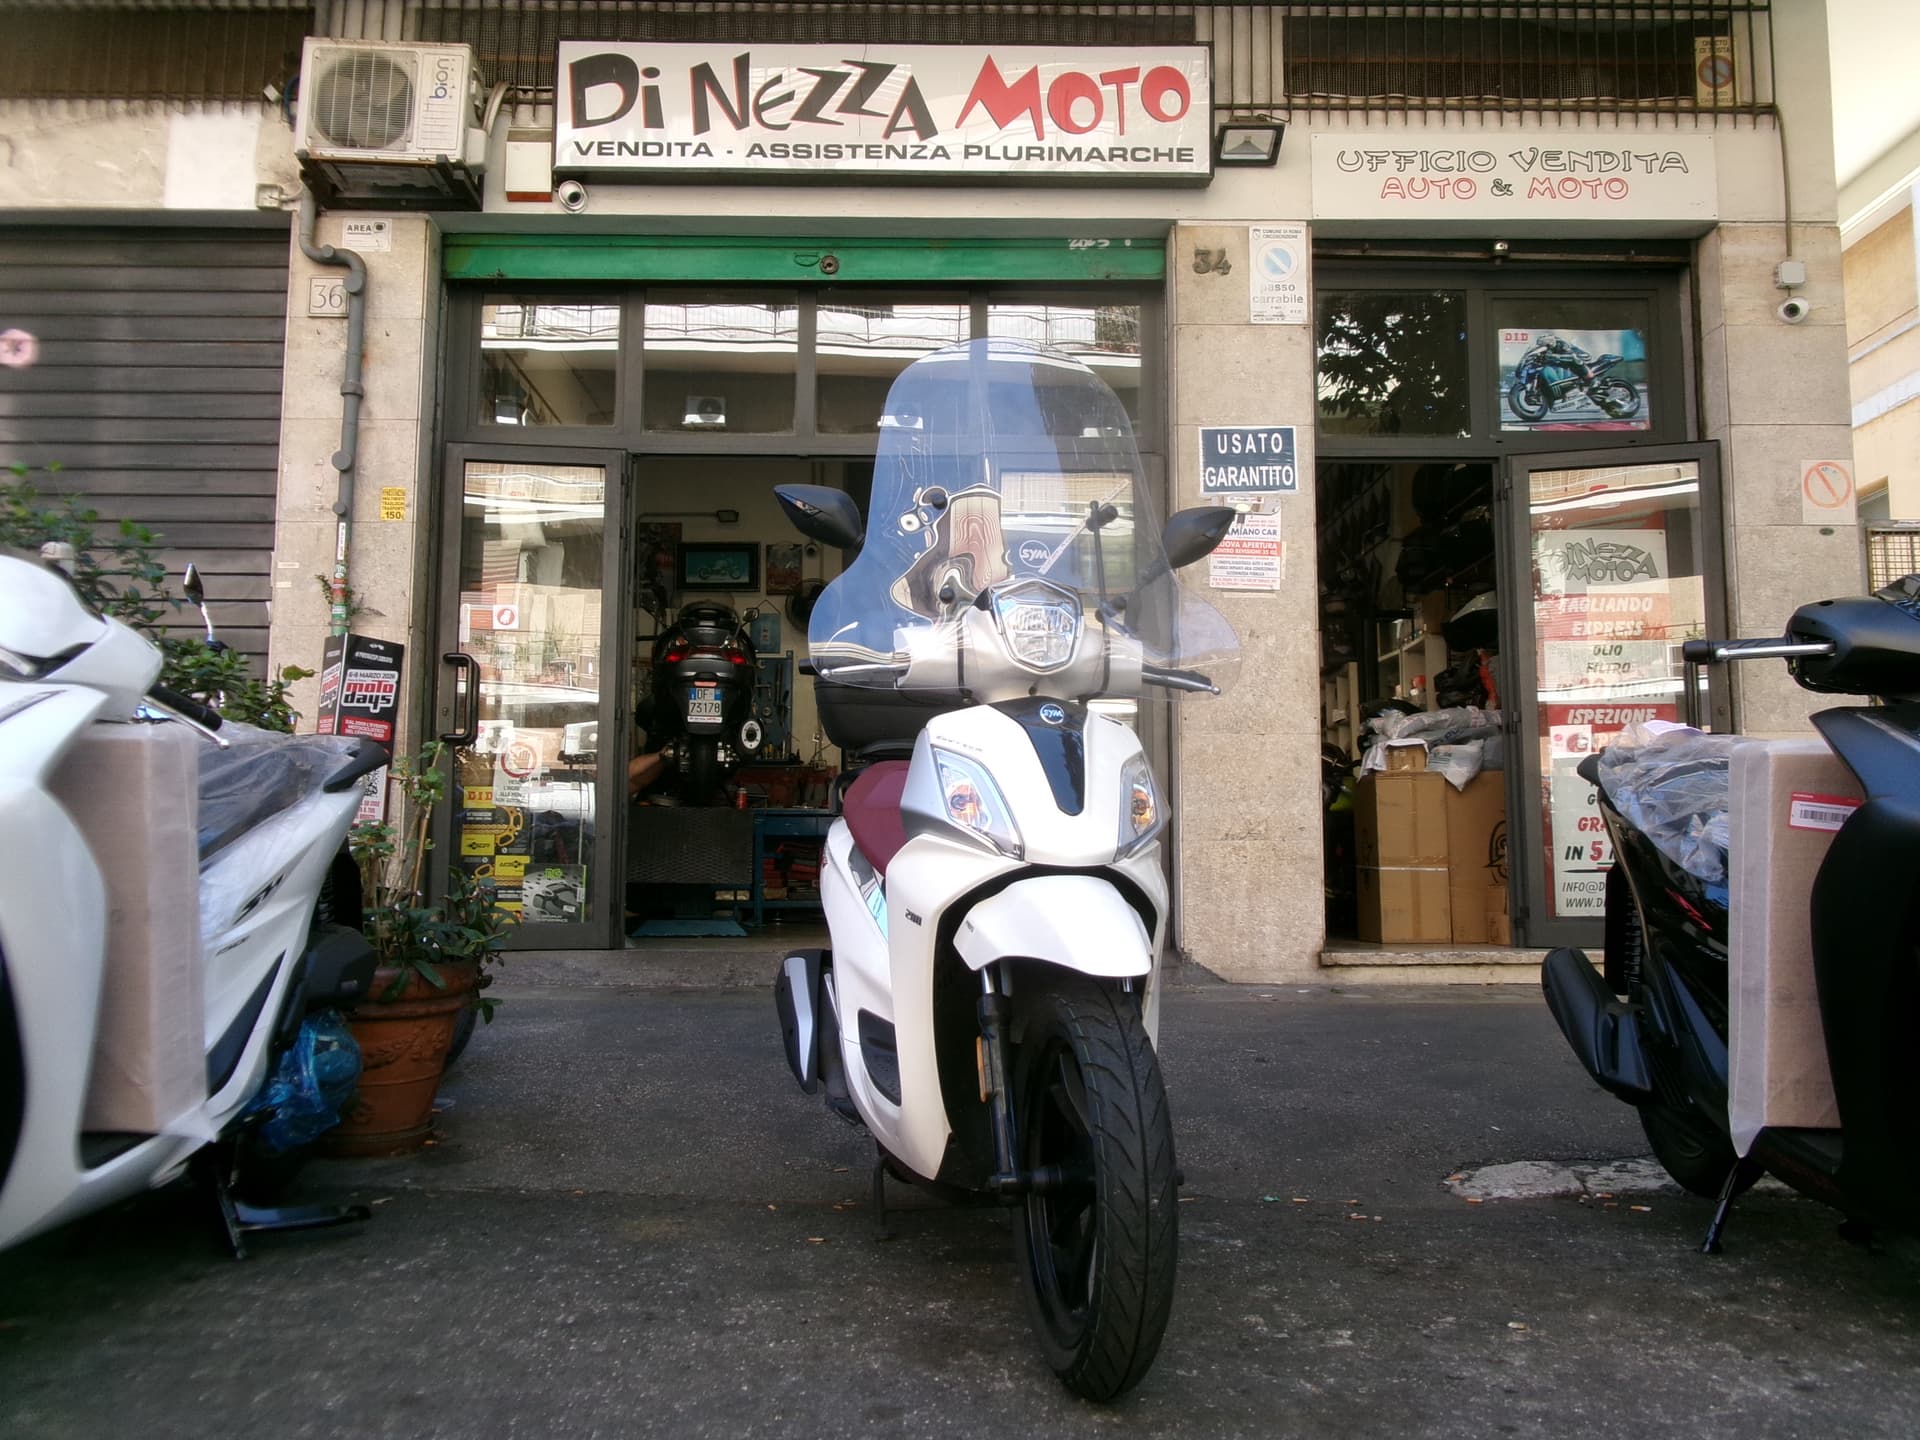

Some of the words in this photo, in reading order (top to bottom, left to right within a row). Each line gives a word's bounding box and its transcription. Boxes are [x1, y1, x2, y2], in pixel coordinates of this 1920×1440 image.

[568, 52, 665, 130] Di
[955, 53, 1192, 142] MOTO
[574, 140, 714, 158] VENDITA
[745, 142, 952, 161] ASSISTENZA
[963, 144, 1195, 163] PLURIMARCHE
[1337, 150, 1498, 173] UFFICIO
[1508, 147, 1689, 174] VENDITA
[1381, 176, 1477, 200] AUTO
[1490, 178, 1514, 197] &
[1527, 176, 1630, 200] MOTO
[347, 224, 372, 232] AREA
[1193, 249, 1233, 276] 34
[311, 284, 345, 309] 36
[1251, 294, 1305, 304] carrabile
[1504, 332, 1529, 342] DID
[1217, 432, 1283, 454] USATO
[1204, 465, 1294, 488] GARANTITO
[1261, 528, 1277, 536] CAR
[1242, 541, 1277, 549] APERTURA
[1021, 548, 1048, 561] SYM
[1566, 560, 1636, 585] MOTO
[1559, 596, 1654, 613] TAGLIANDO
[1572, 620, 1645, 637] EXPRESS
[1593, 644, 1623, 656] OLIO
[1586, 662, 1632, 674] FILTRO
[346, 679, 395, 693] moto
[343, 690, 393, 712] days
[690, 702, 721, 714] 73178
[1567, 708, 1656, 725] ISPEZIONE
[1565, 845, 1584, 861] IN
[1590, 840, 1604, 861] 5
[1562, 881, 1606, 894] INFO@D
[1566, 897, 1604, 909] WWW.D
